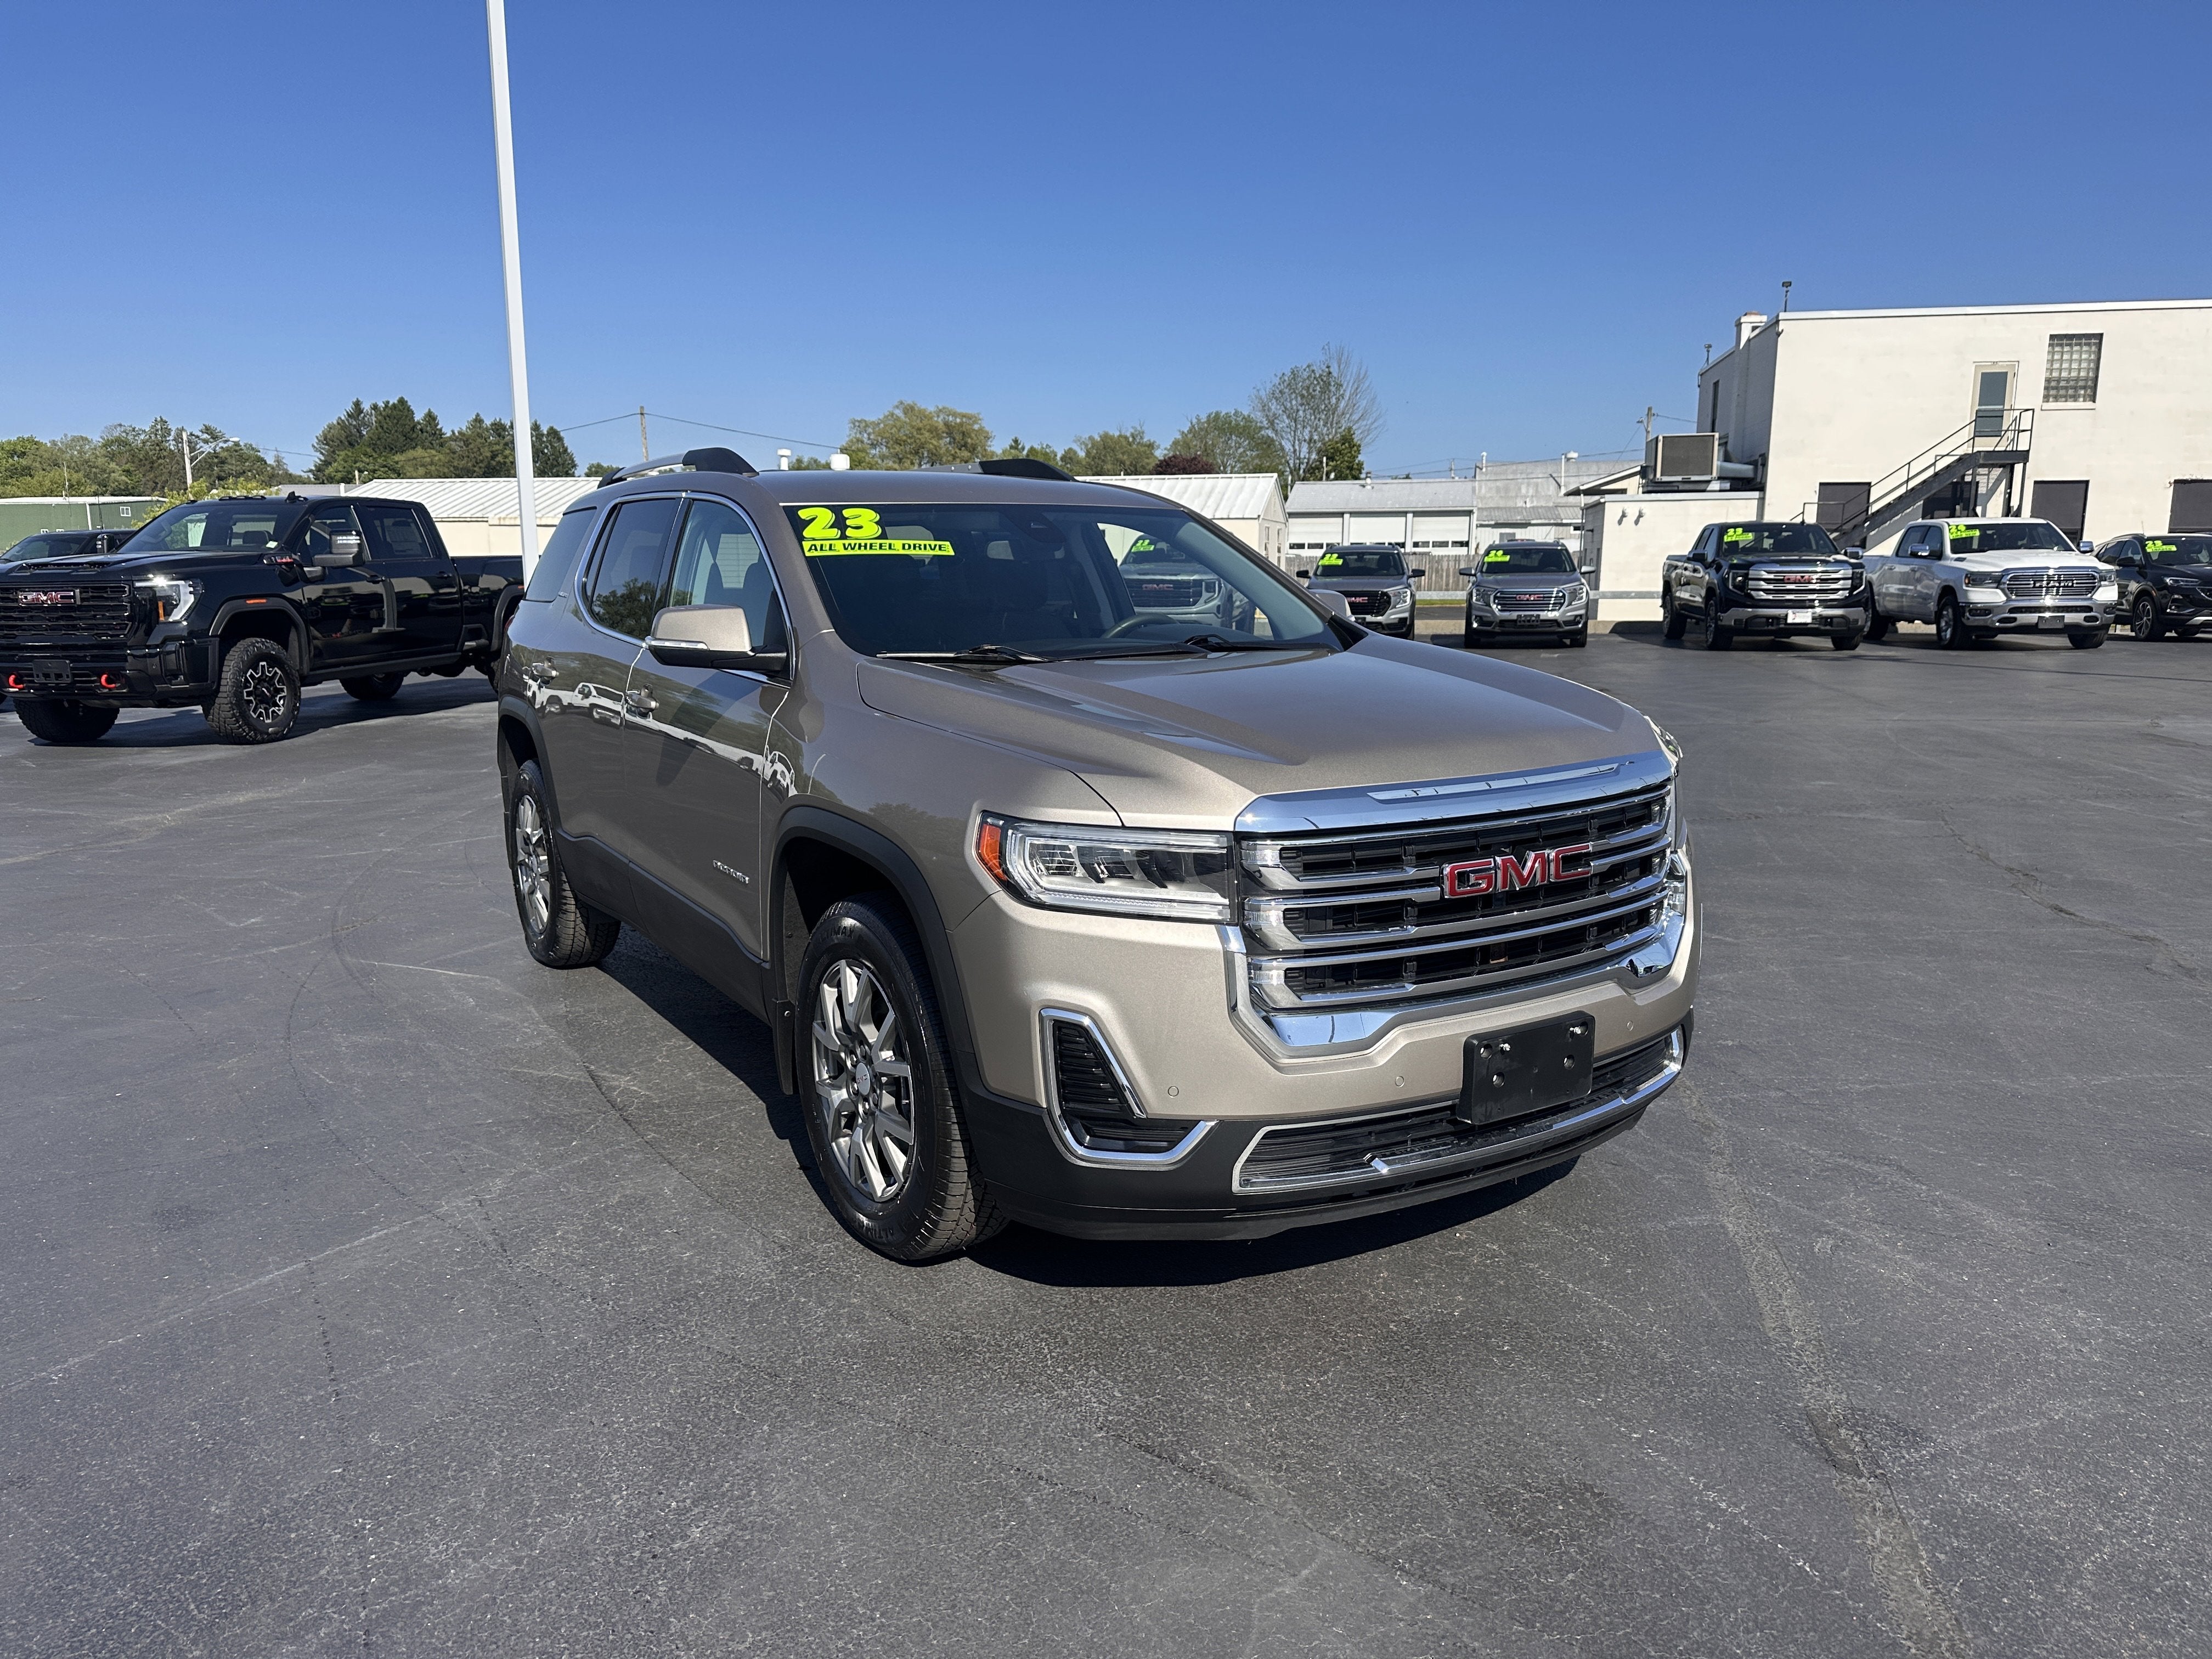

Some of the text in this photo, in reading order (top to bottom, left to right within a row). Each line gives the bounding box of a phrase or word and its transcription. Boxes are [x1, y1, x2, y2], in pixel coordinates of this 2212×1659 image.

[798, 507, 882, 540] 23
[807, 542, 950, 553] ALL WHEEL DRIVE
[19, 591, 75, 604] GMC
[713, 860, 749, 884] ACADIA
[1443, 842, 1593, 900] GMC
[856, 1074, 868, 1084] GMC
